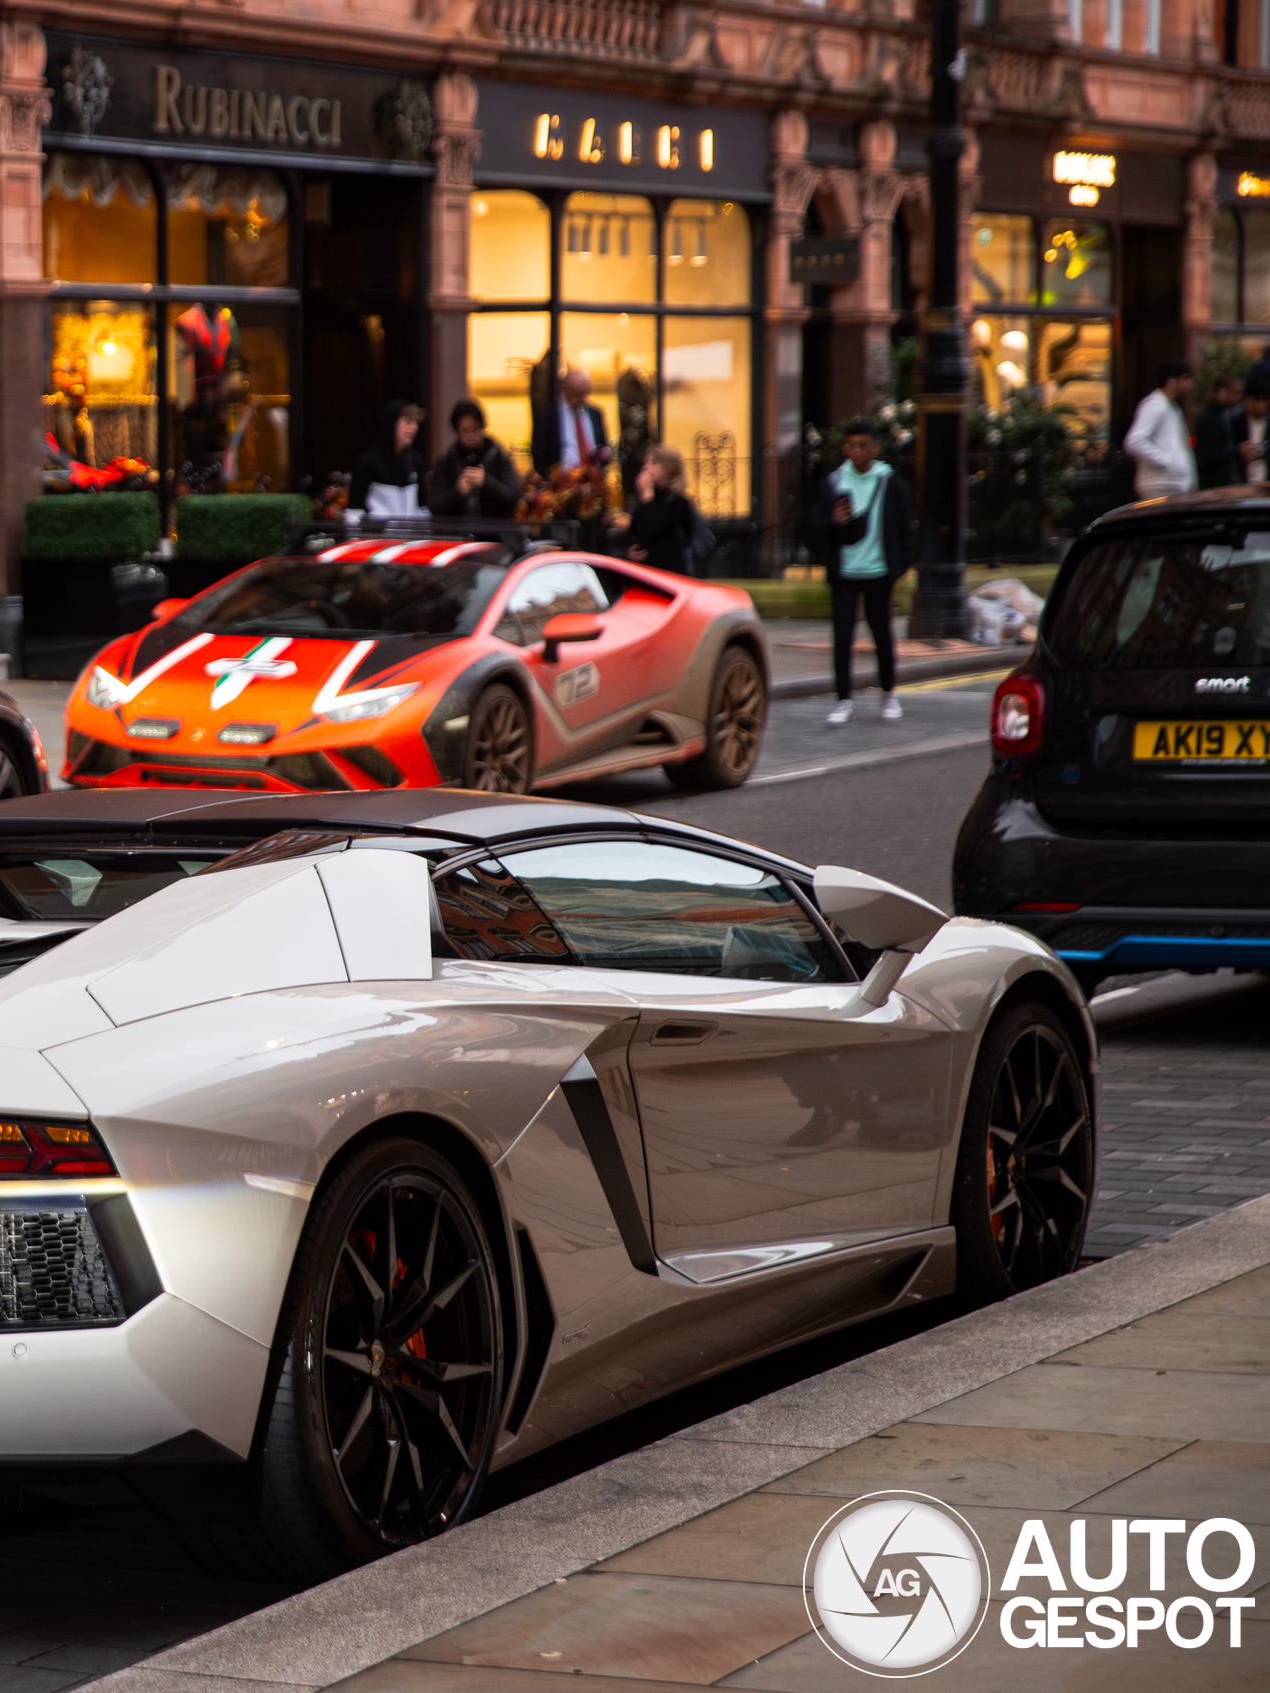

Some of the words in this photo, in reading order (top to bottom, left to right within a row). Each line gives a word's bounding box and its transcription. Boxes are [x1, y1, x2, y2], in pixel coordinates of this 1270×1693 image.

[560, 667, 595, 703] 72
[1194, 676, 1250, 693] smart
[1152, 725, 1224, 755] AK19
